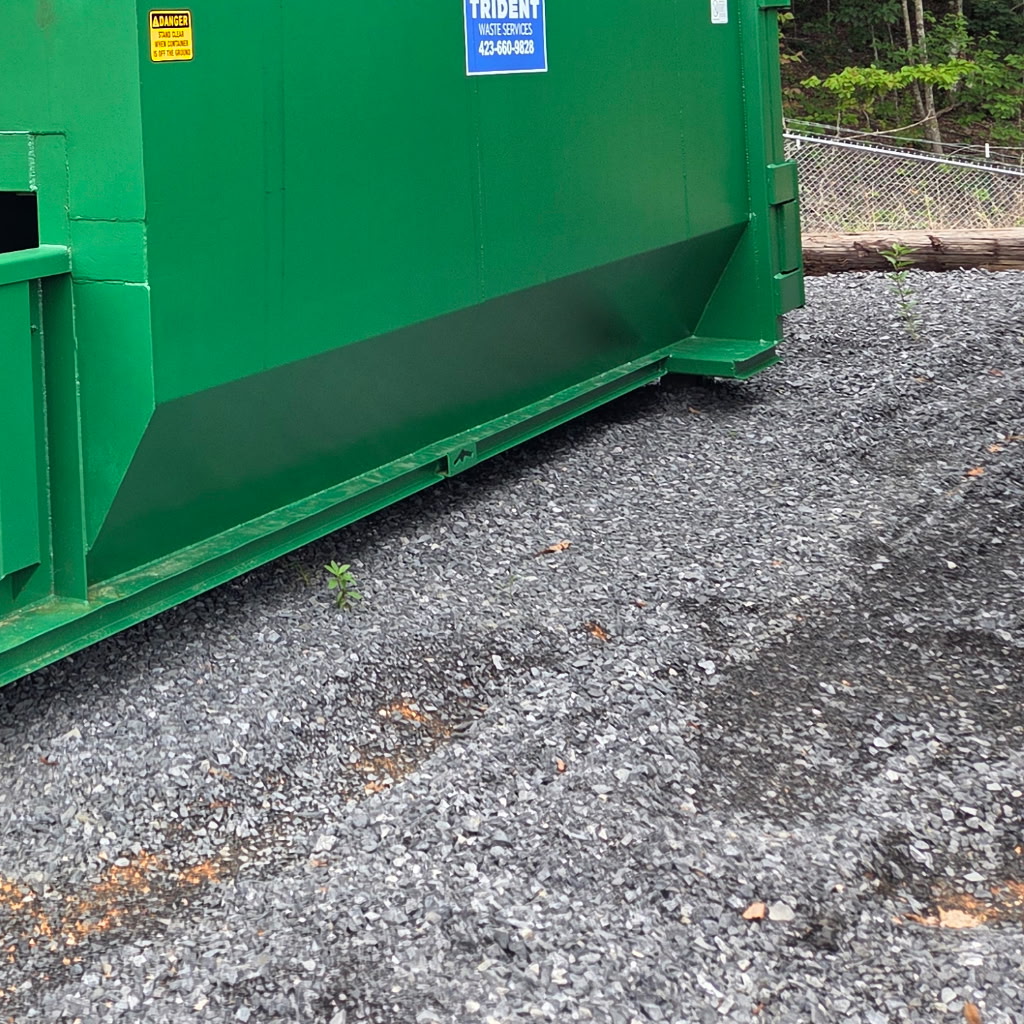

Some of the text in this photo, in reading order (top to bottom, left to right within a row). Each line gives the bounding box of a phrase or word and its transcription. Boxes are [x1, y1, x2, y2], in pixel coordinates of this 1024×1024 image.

[158, 15, 189, 27] DANGER
[478, 22, 533, 36] WASTE SERVICES
[478, 39, 535, 56] 423-660-9828
